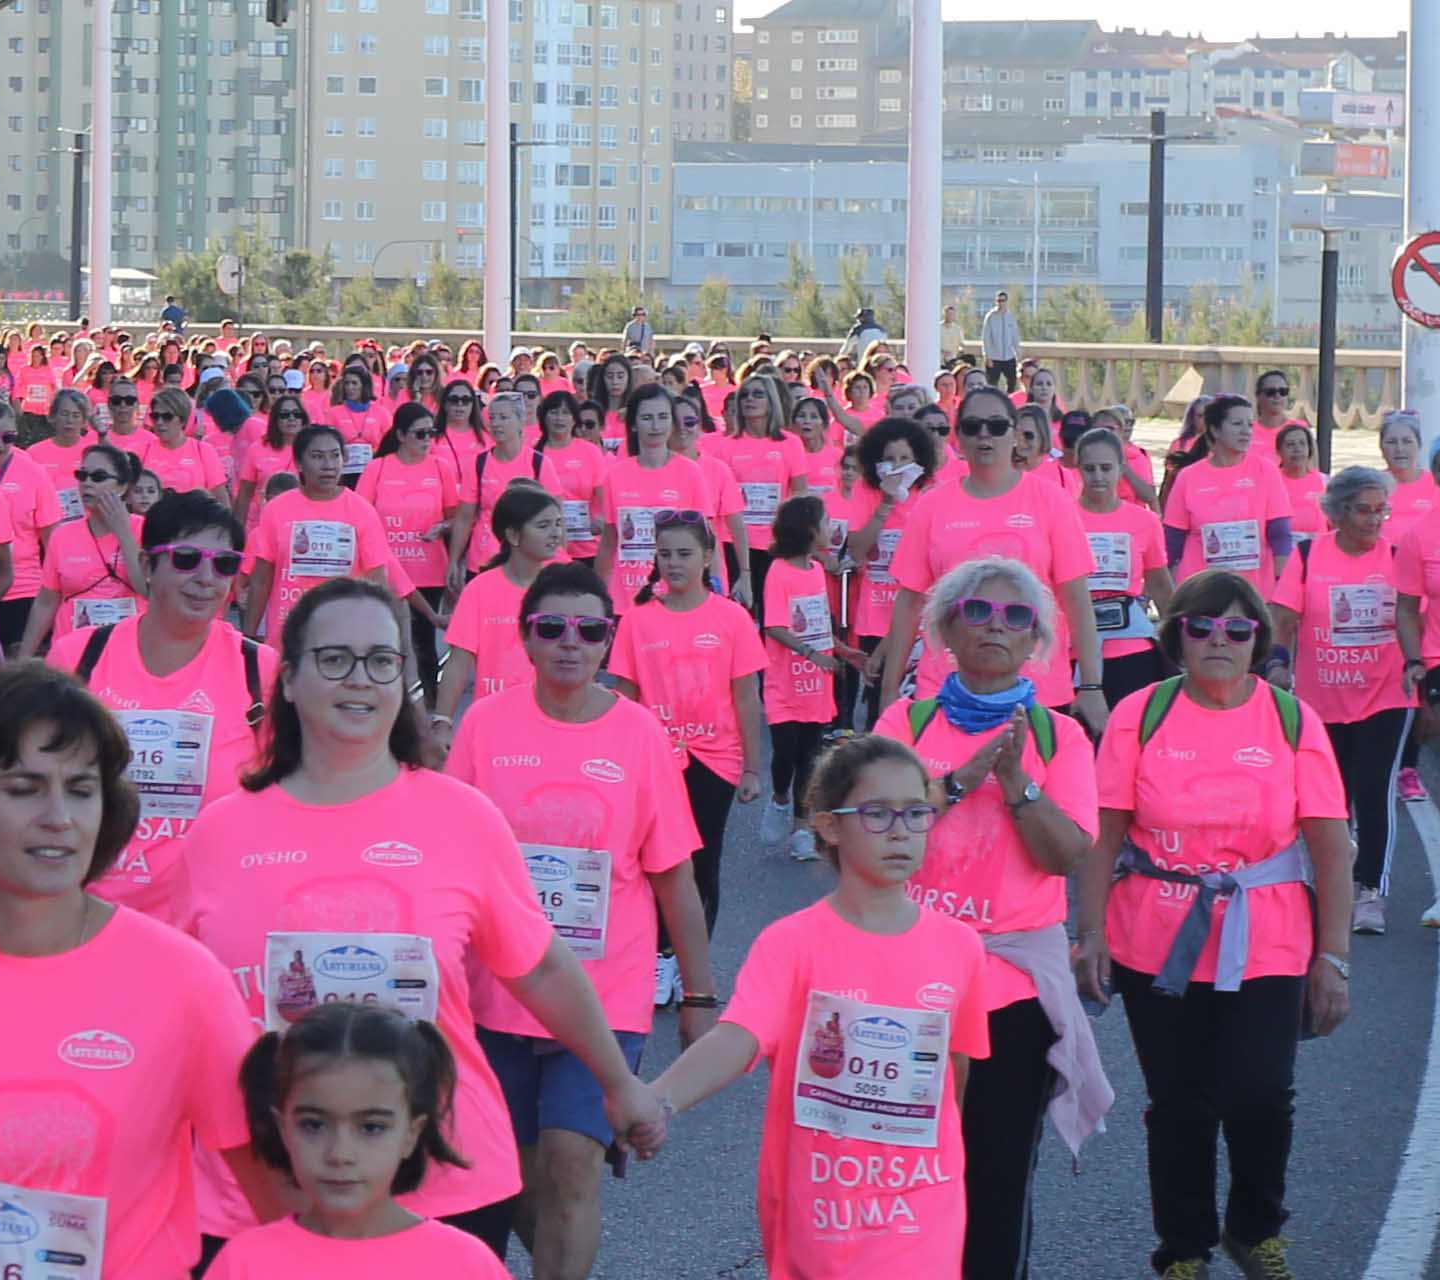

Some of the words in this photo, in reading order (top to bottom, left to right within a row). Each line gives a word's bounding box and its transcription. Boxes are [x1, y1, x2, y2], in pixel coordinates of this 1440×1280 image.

[387, 531, 422, 543] DORS
[311, 541, 333, 552] 016
[1095, 555, 1110, 565] 16
[1353, 607, 1379, 618] 016
[130, 749, 164, 765] 16
[240, 849, 308, 869] OYSHO
[537, 891, 563, 908] 16
[321, 957, 382, 971] ASTURIANA
[848, 1056, 900, 1080] 016
[811, 1153, 952, 1188] DORSAL
[813, 1195, 915, 1231] SUMA
